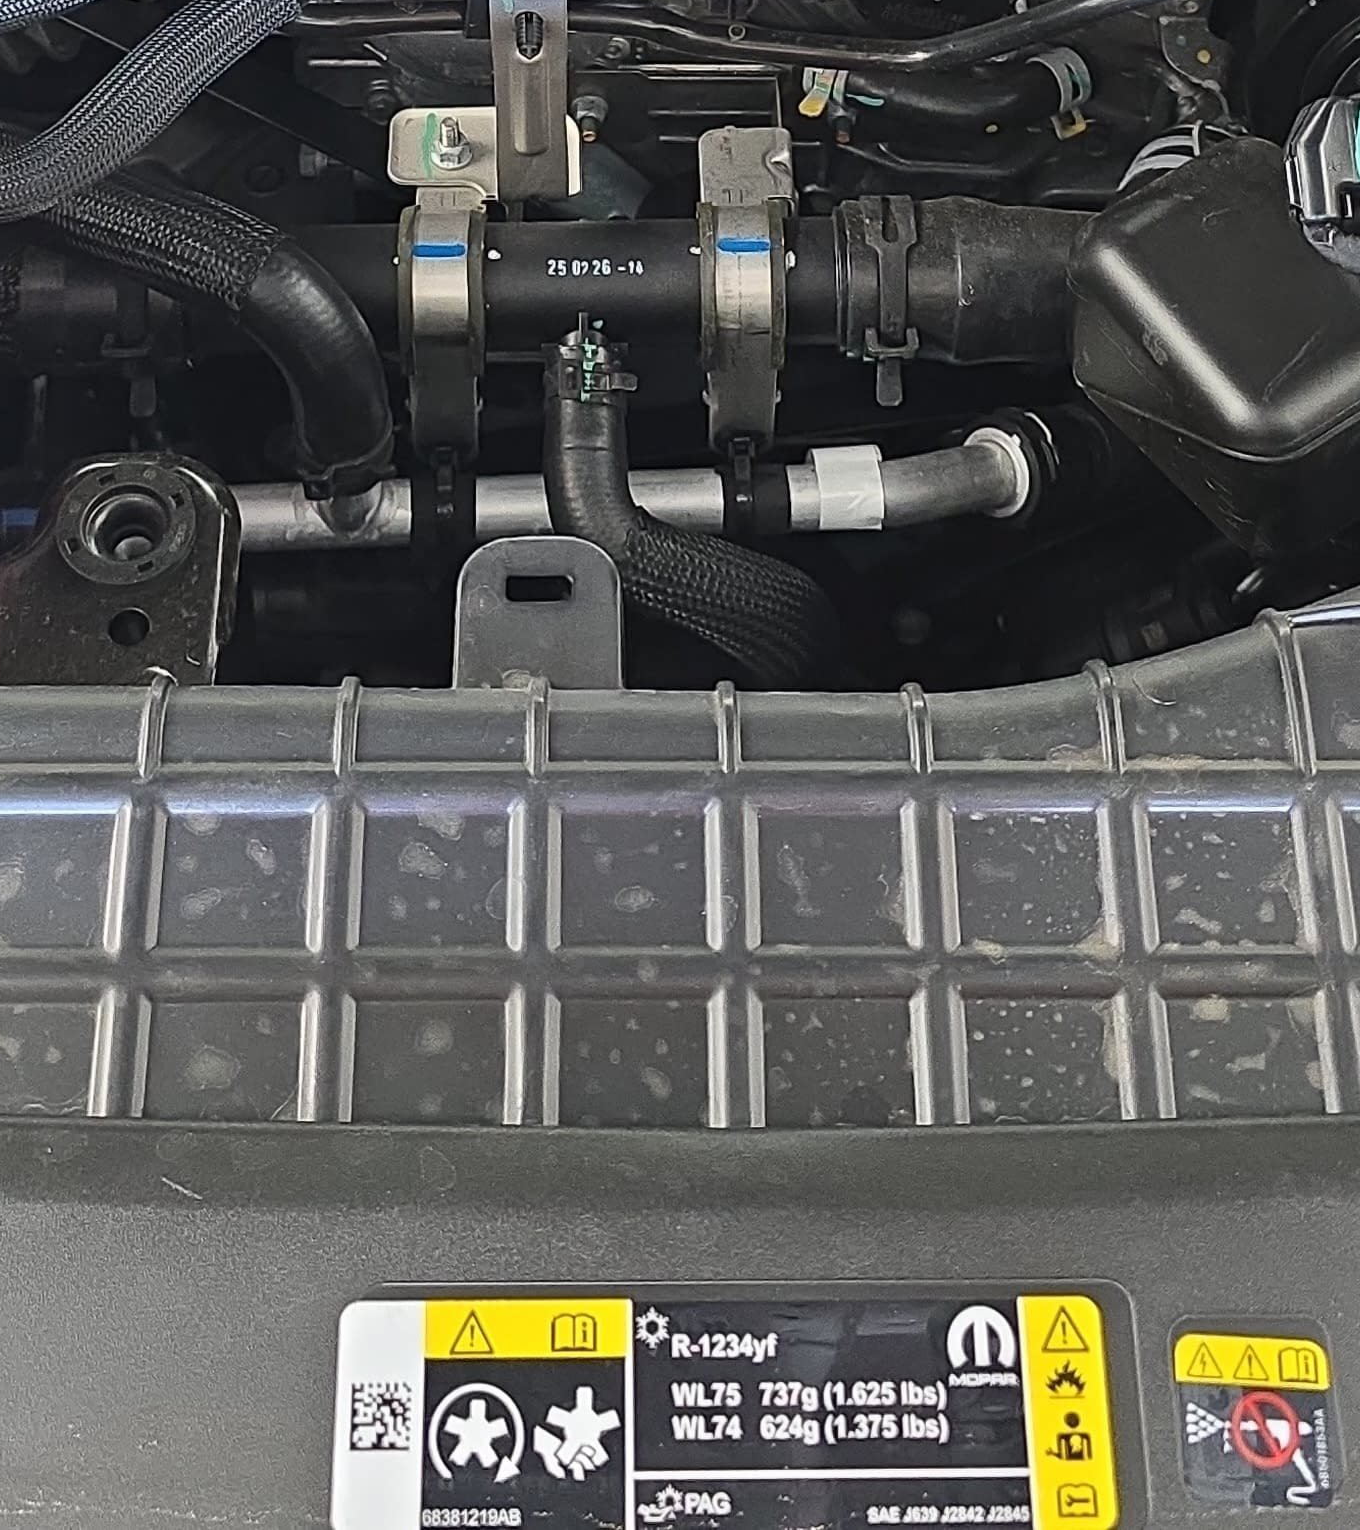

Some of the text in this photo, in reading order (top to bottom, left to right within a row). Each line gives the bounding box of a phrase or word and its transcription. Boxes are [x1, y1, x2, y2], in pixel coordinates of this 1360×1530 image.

[670, 1332, 779, 1363] R-1234yf
[947, 1372, 1020, 1388] MOPAR
[670, 1380, 948, 1413] WL75 737g (1.625 lbs)
[670, 1413, 951, 1445] WL74 624g (1.375 lbs)
[683, 1491, 733, 1516] PAG
[866, 1504, 1031, 1524] SAE J639 J2842 J2845
[421, 1507, 523, 1527] 68381219AB
